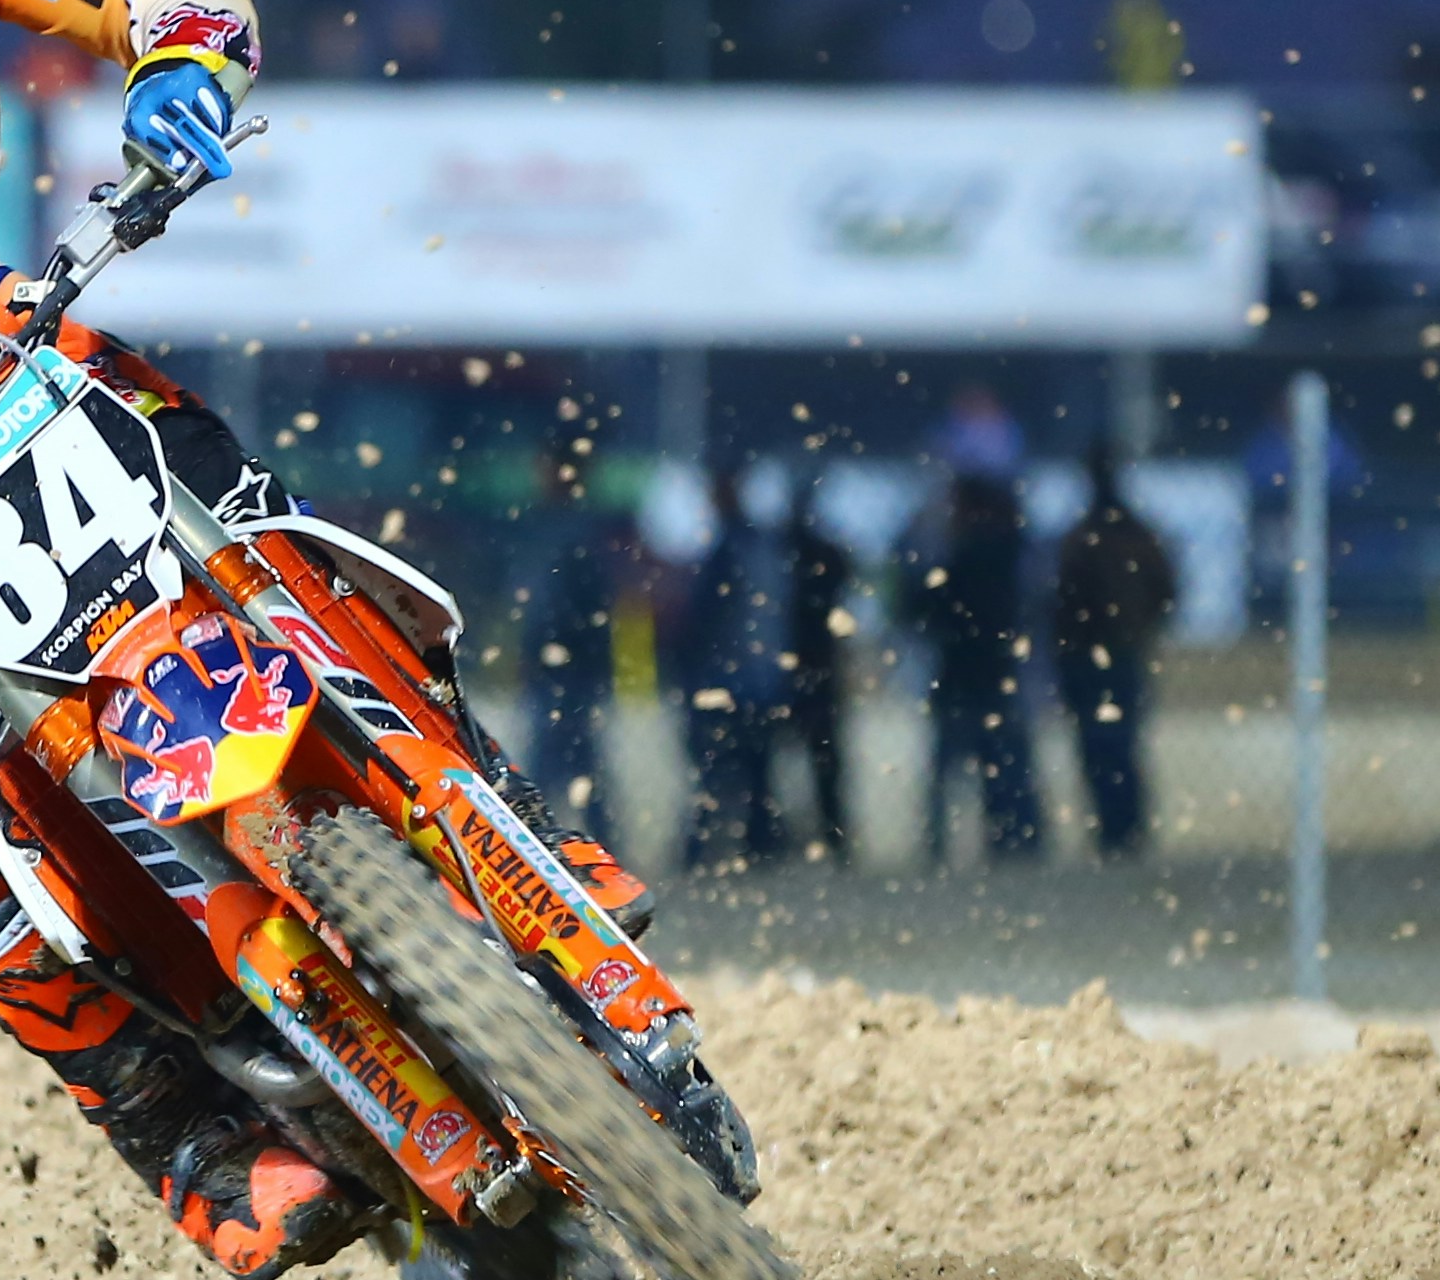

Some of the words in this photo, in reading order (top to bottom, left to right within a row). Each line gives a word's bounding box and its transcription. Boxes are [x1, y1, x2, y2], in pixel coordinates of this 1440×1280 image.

[41, 590, 114, 667] SCORPION
[110, 559, 143, 597] BAY
[85, 599, 136, 656] KTM
[460, 809, 565, 918] ATHENA
[298, 951, 419, 1069] PIRELLI
[273, 1004, 397, 1145] MOTOREX
[320, 1020, 420, 1131] ATHENA
